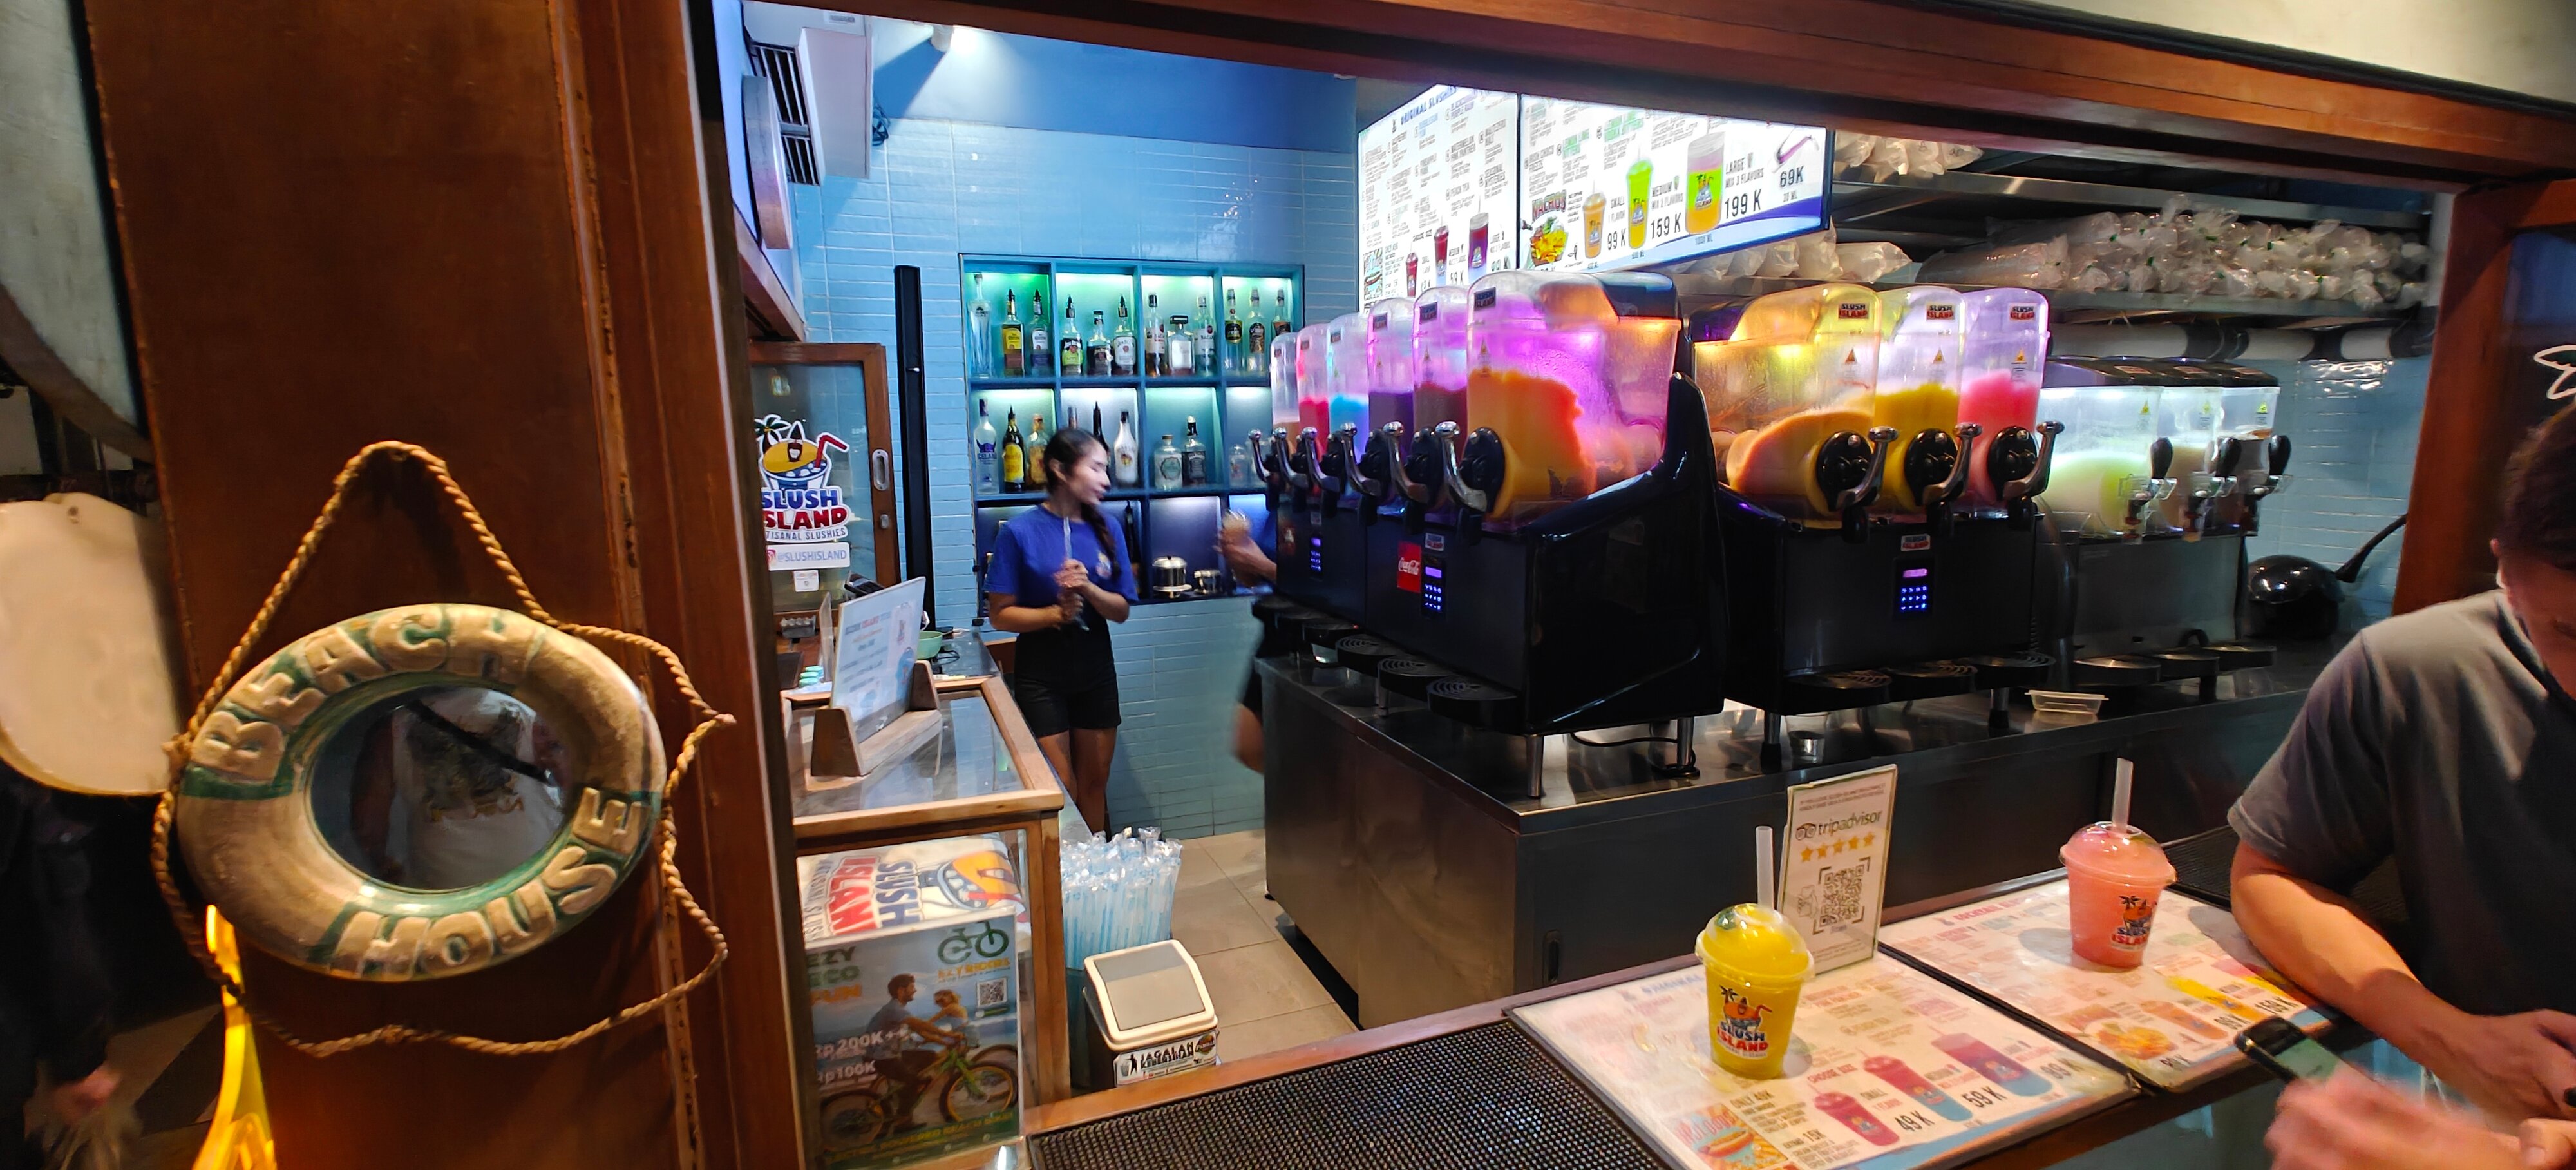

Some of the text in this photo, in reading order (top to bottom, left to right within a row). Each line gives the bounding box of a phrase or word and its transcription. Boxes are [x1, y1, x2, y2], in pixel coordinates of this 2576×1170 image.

[1725, 158, 1745, 175] LARGE
[1779, 166, 1804, 187] 69K
[1725, 189, 1762, 219] 199 K
[1651, 213, 1681, 239] 159 K
[1607, 228, 1626, 251] 99 K
[761, 489, 838, 509] SLUSH
[763, 507, 848, 530] SLAND
[766, 528, 846, 540] TISANAL SLUSHIES
[777, 549, 847, 562] @SLUSHISLAND
[189, 606, 533, 785] BEACH
[1818, 810, 1883, 836] tripadvisor
[328, 786, 652, 980] HOUSE
[875, 861, 922, 927] SLUSH
[1717, 1026, 1769, 1052] ISLAND
[1720, 1021, 1765, 1041] SLUSH
[1960, 1086, 2007, 1108] 59 K
[1894, 1110, 1935, 1132] 49 K
